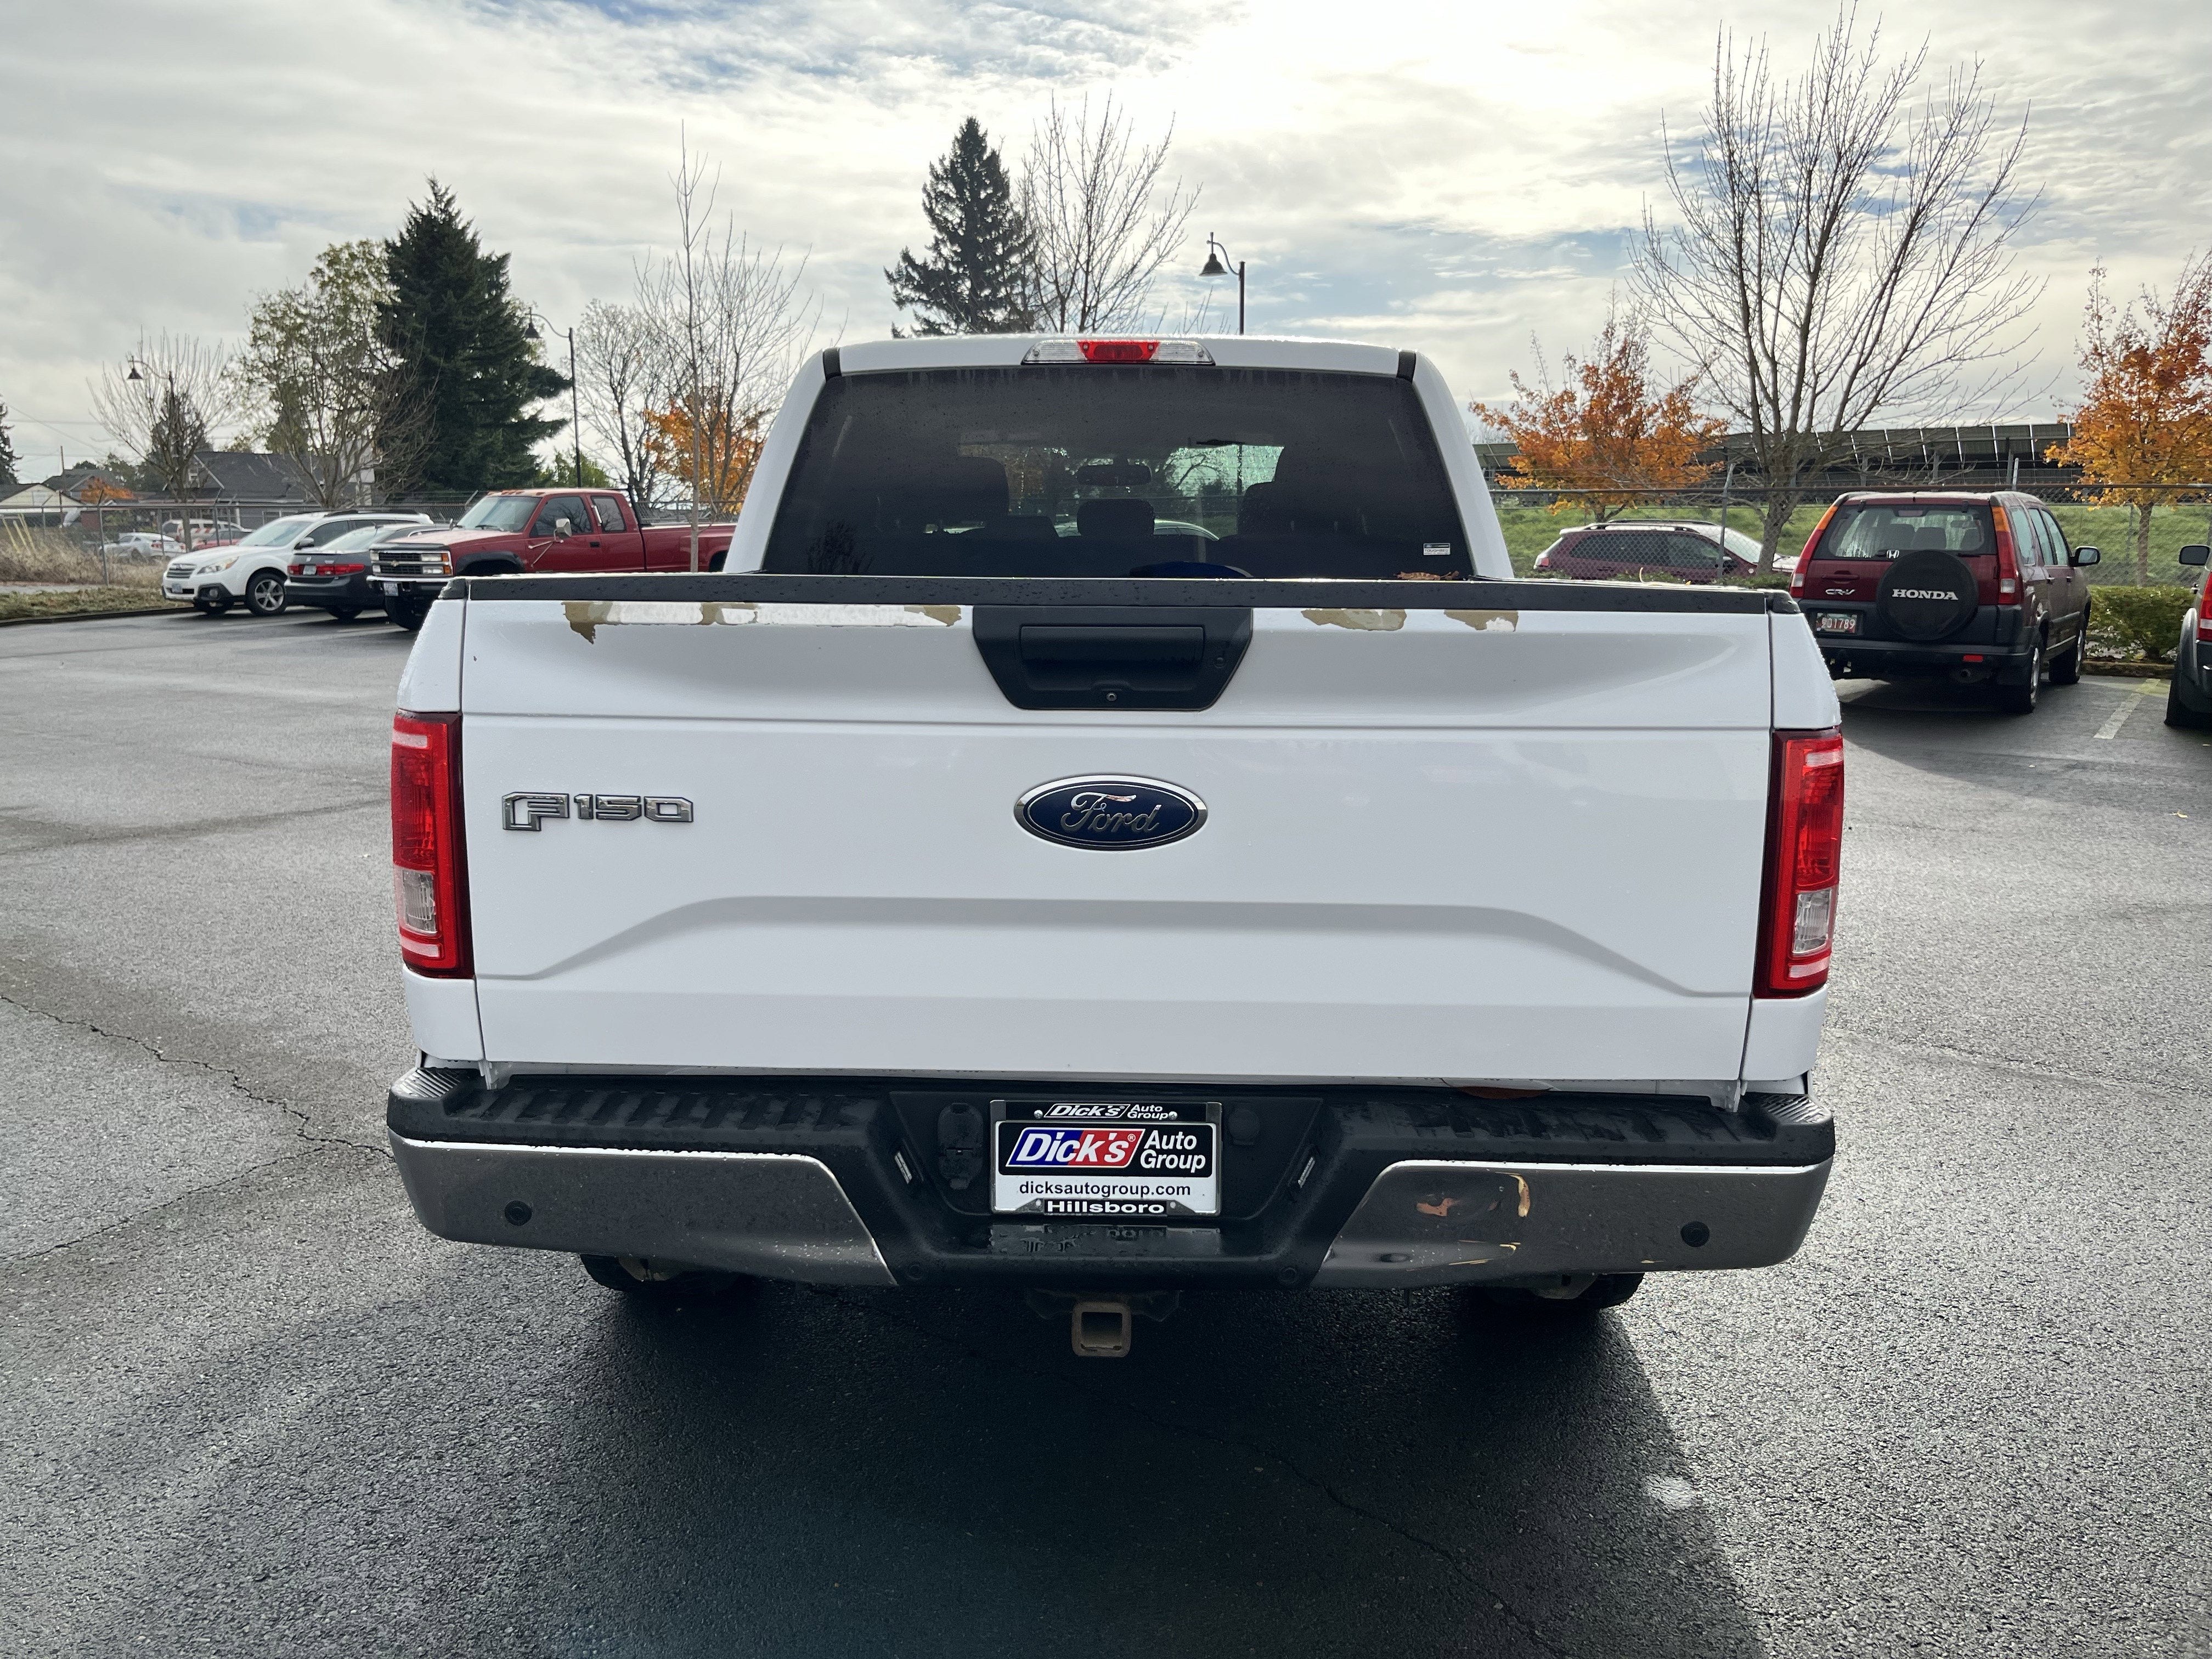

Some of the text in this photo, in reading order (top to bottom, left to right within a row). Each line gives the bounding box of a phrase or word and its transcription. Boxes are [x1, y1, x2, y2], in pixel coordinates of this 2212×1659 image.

[1892, 589, 1959, 600] HONDA
[1060, 792, 1162, 833] Ford
[1050, 1105, 1120, 1116] Dick's
[1127, 1111, 1168, 1120] Group
[1016, 1132, 1128, 1163] Dick's
[1144, 1130, 1197, 1150] Auto
[1140, 1149, 1206, 1173] Group
[1019, 1181, 1191, 1198] dicksautogroup.com
[1047, 1201, 1164, 1214] Hillsboro
